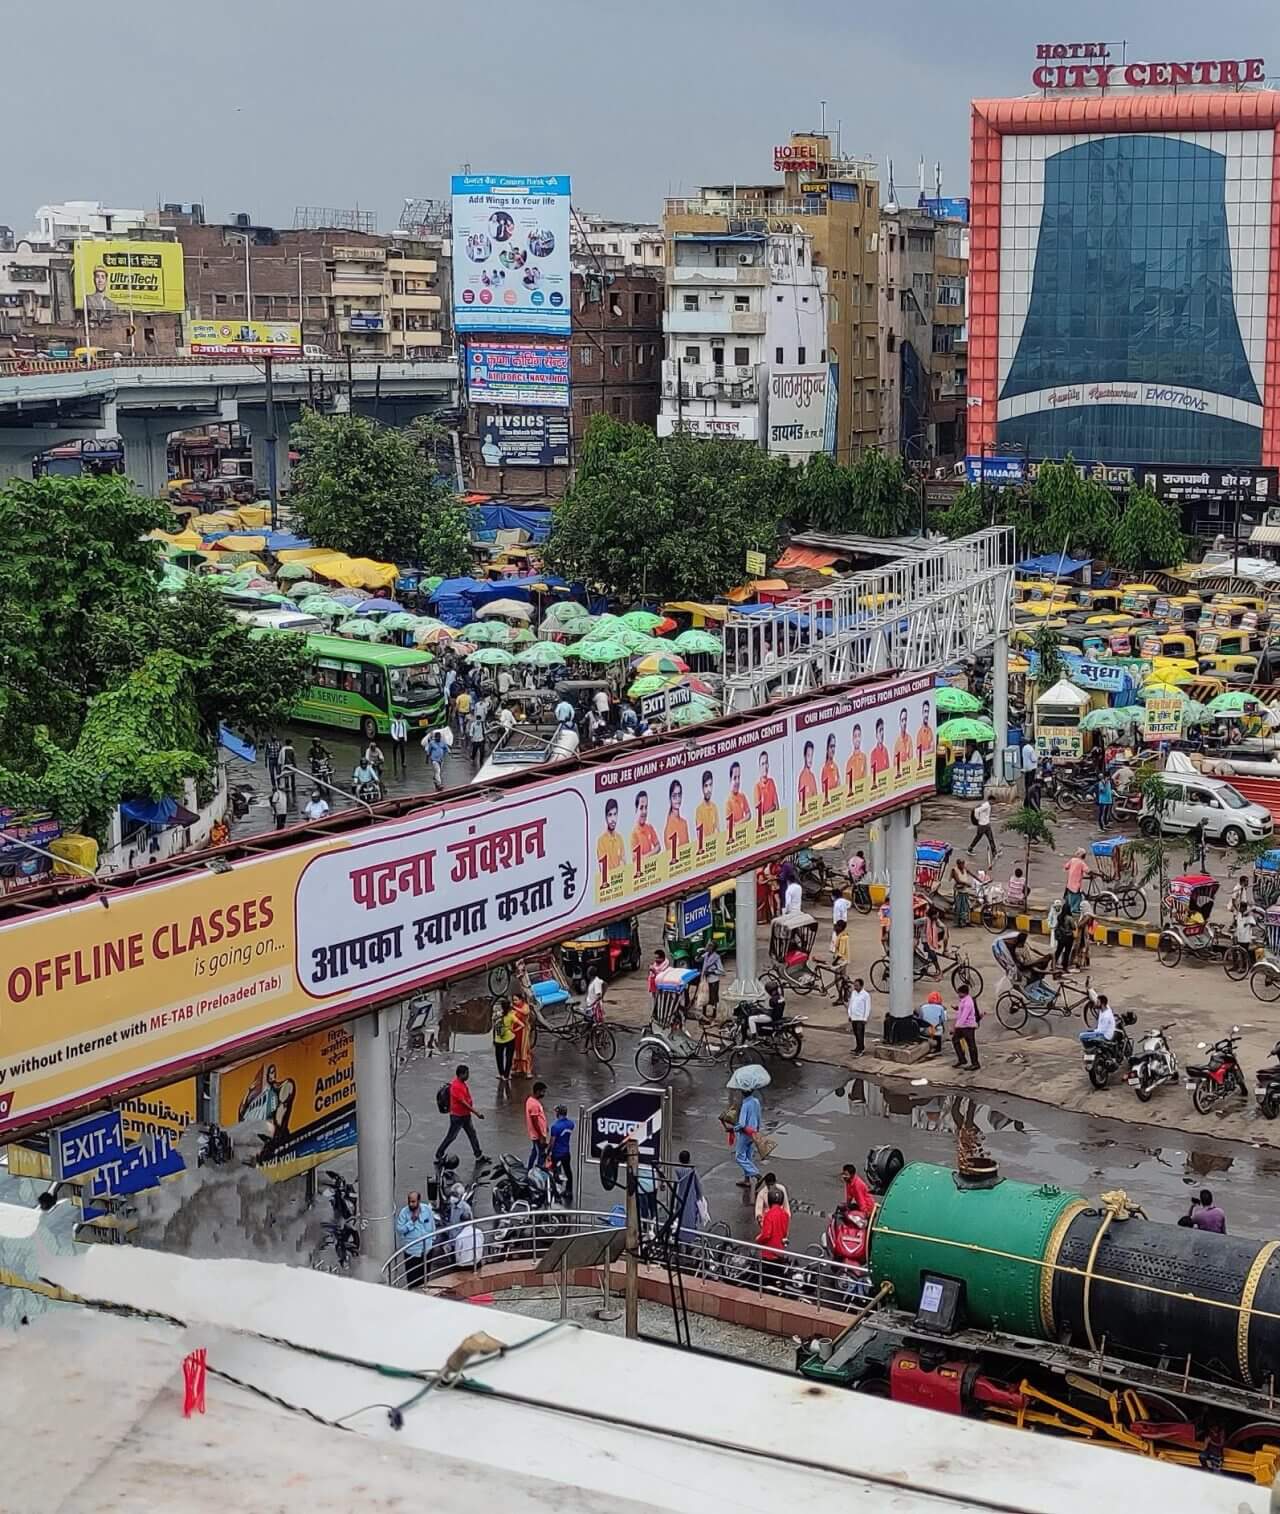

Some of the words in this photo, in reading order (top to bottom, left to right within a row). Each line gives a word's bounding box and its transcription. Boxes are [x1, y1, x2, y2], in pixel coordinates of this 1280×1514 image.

[1036, 43, 1110, 59] HOTEL
[1032, 65, 1116, 89] CITY
[1124, 59, 1265, 87] CENTRE
[774, 146, 817, 159] HOTEL
[469, 195, 484, 204] Add
[486, 196, 509, 206] Wings
[511, 197, 520, 205] to
[523, 197, 540, 205] Your
[542, 196, 555, 205] life
[109, 270, 158, 285] UltraTech
[1145, 388, 1209, 411] EMOTIONS
[486, 415, 544, 427] PHYSICS
[771, 419, 805, 442] डायमंड
[1091, 462, 1135, 482] होटल
[1080, 663, 1120, 681] सुधा
[318, 690, 348, 705] SERVICE
[643, 694, 665, 714] EXIT
[669, 686, 690, 705] ENTRY
[804, 711, 818, 725] OUR
[852, 694, 877, 710] TOPPERS
[877, 689, 893, 703] FROM
[893, 684, 912, 698] PATNA
[911, 677, 931, 692] CENTRE
[601, 772, 619, 786] OUR
[619, 768, 632, 783] JEE
[634, 761, 658, 783] (MAIN
[666, 752, 687, 770] ADV.)
[687, 745, 717, 764] TOPPERS
[717, 740, 738, 755] FROM
[737, 731, 760, 749] PATNA
[760, 723, 784, 740] CENTRE
[895, 751, 903, 780] 1
[917, 744, 925, 771] 1
[846, 767, 855, 799] 1
[871, 760, 879, 791] 1
[799, 784, 808, 817] 1
[823, 776, 831, 807] 1
[726, 812, 736, 846] 1
[755, 801, 765, 833] 1
[669, 831, 680, 866] 1
[696, 823, 706, 856] 1
[349, 849, 437, 911] पटना
[446, 817, 548, 883] जंक्शन
[599, 853, 610, 890] 1
[633, 844, 644, 879] 1
[311, 924, 404, 984] आपका
[412, 897, 488, 951] स्वागत
[496, 876, 554, 922] करता
[559, 860, 578, 900] है
[7, 933, 145, 1003] OFFLINE
[151, 895, 274, 960] CLASSES
[194, 956, 206, 977] is
[209, 946, 251, 977] going
[256, 938, 286, 956] on...
[9, 1049, 63, 1078] without
[65, 1031, 119, 1060] Internet
[120, 1020, 148, 1041] with
[150, 1005, 194, 1032] ME-TAB
[195, 981, 257, 1018] (Preloaded
[259, 973, 283, 994] Tab)
[315, 1060, 354, 1095] Ambuj
[314, 1082, 357, 1113] Cemen
[62, 1122, 123, 1168] EXIT-1
